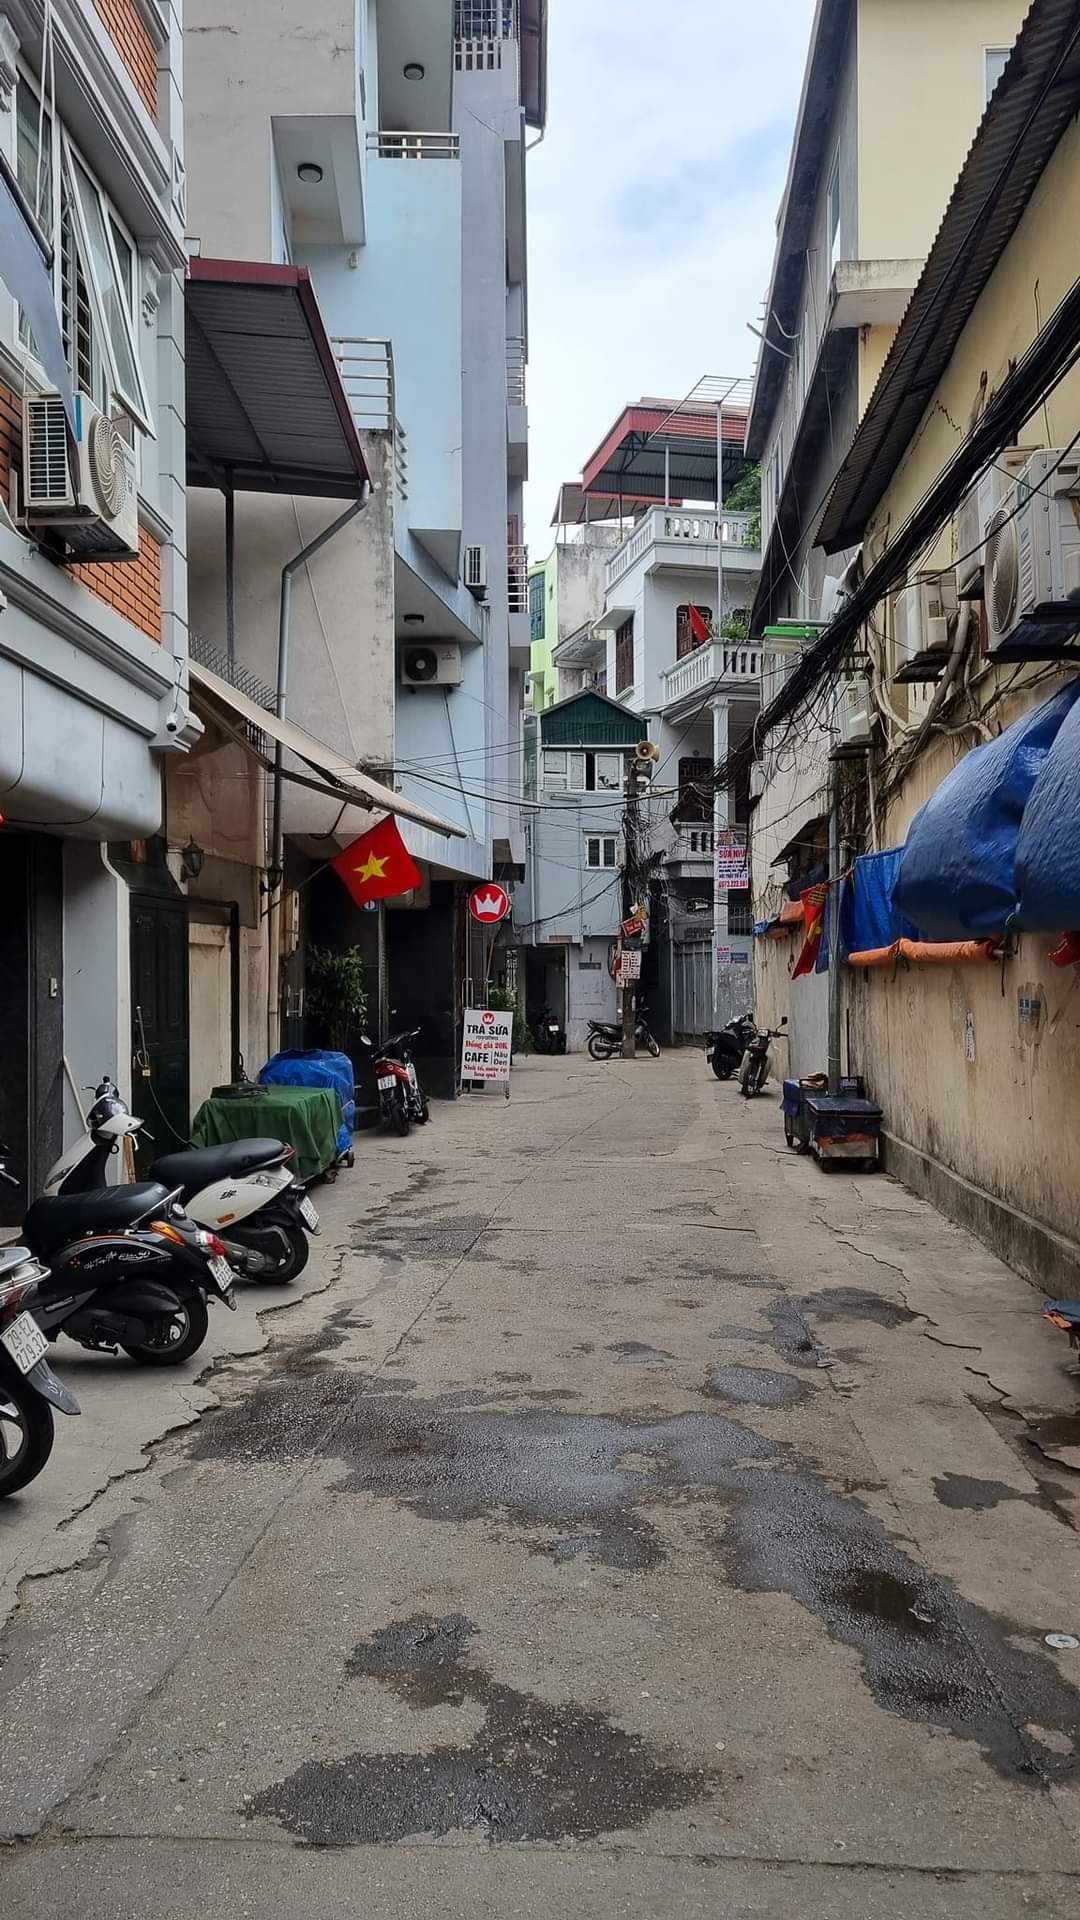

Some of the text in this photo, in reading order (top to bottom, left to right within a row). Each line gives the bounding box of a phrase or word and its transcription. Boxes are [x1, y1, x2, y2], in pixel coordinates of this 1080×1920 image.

[467, 1023, 509, 1036] TRÀ SỮA
[465, 1052, 488, 1062] CAFE
[16, 1332, 47, 1370] 279.32
